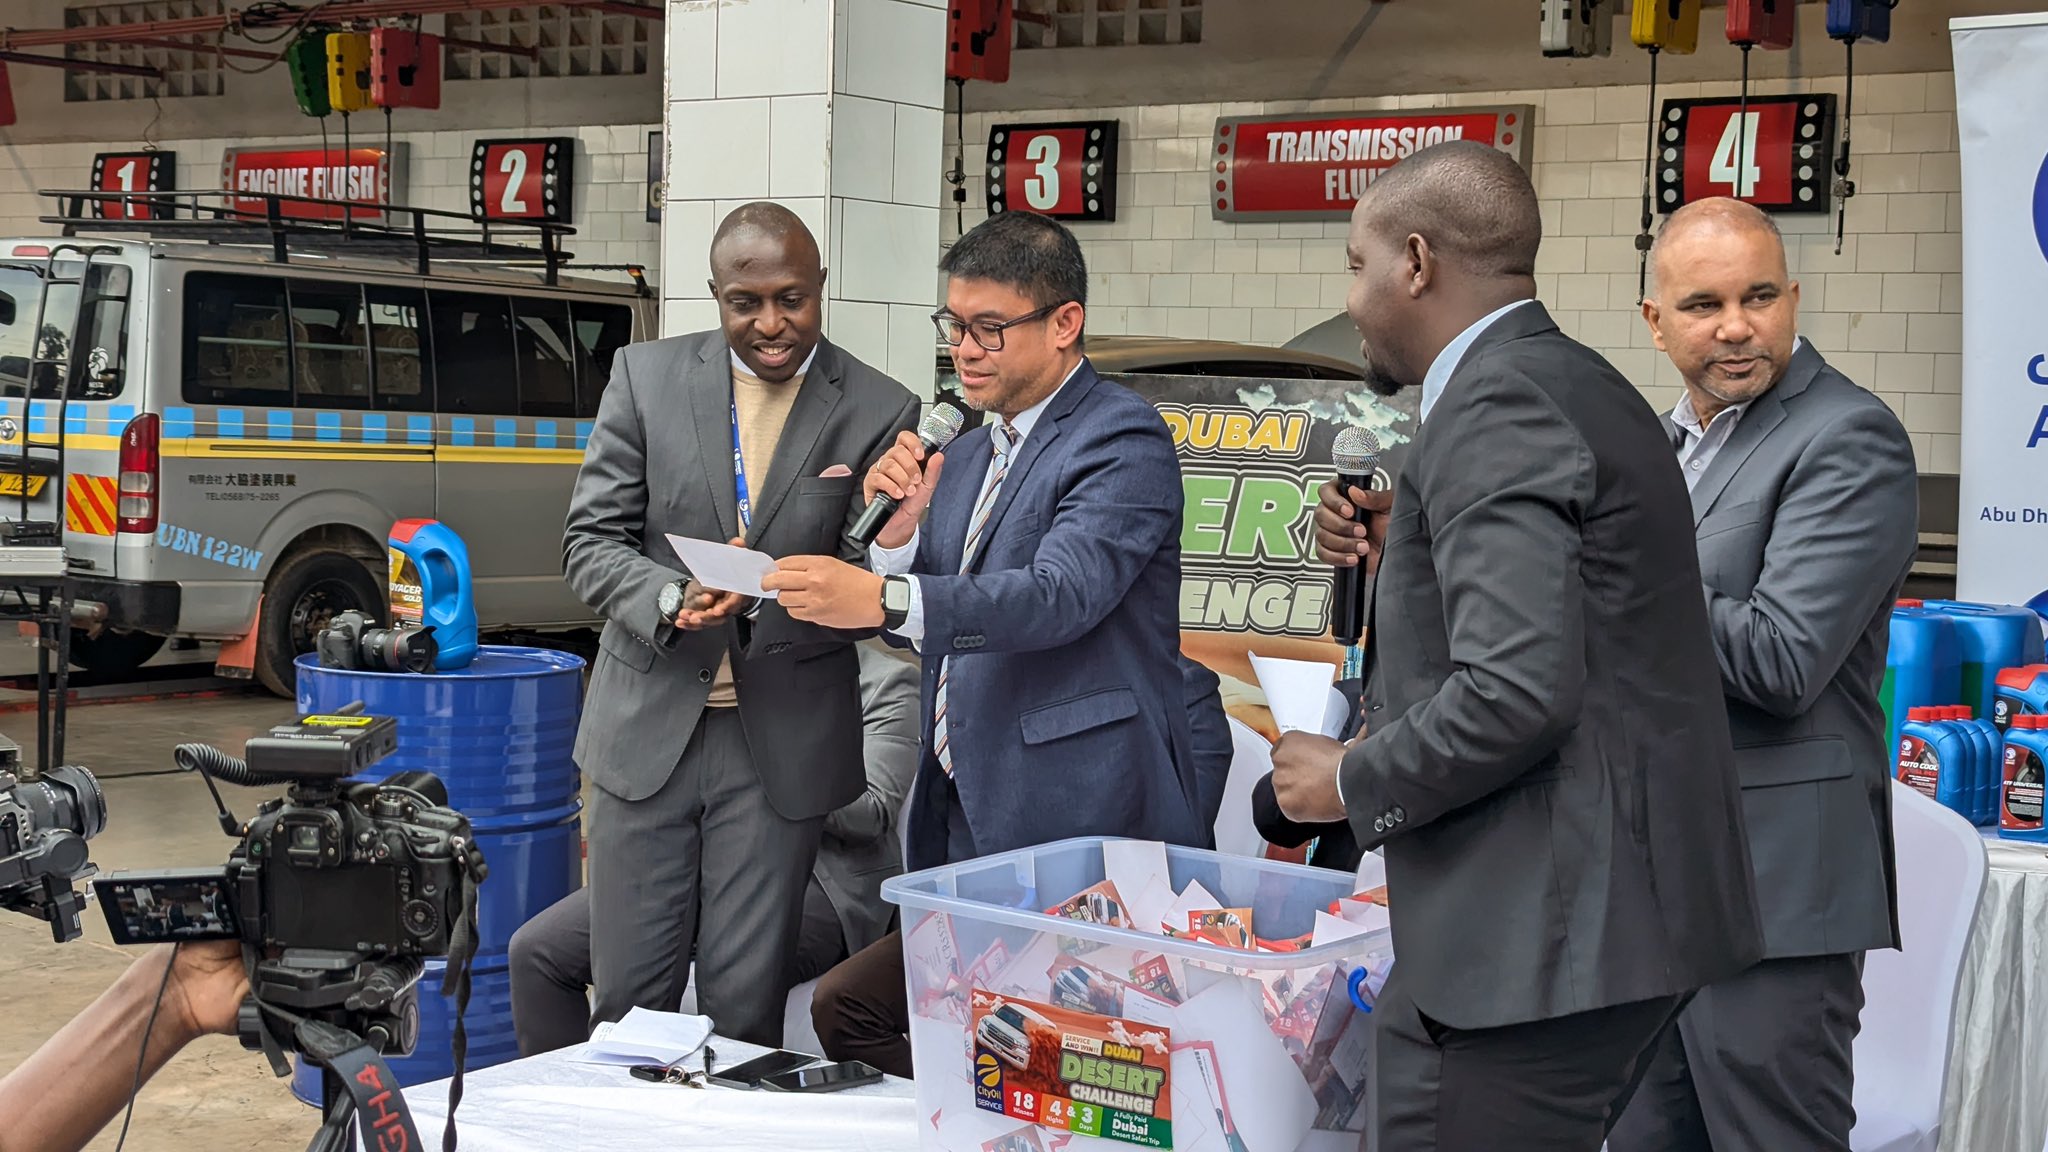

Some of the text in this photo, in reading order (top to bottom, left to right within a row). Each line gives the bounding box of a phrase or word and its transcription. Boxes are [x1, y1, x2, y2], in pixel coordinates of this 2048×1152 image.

[1709, 111, 1760, 197] 4
[500, 149, 527, 213] 2
[1025, 134, 1060, 210] 3
[117, 161, 136, 217] 1
[238, 165, 376, 202] ENGINE FLUSH
[1980, 506, 2016, 522] Abu
[156, 522, 264, 571] UBN 122W
[402, 594, 423, 603] GOLD
[1900, 760, 1938, 771] AUTO COOL
[1065, 1035, 1090, 1045] SERVICE
[1103, 1043, 1142, 1061] DUBAI
[1061, 1054, 1163, 1097] DESERT
[977, 1086, 1002, 1100] CityOil
[1013, 1091, 1034, 1110] 18
[1069, 1083, 1155, 1115] CHALLENGE
[356, 1063, 408, 1152] GH4
[977, 1098, 1003, 1111] SERVICE
[1050, 1100, 1061, 1116] 4
[1081, 1107, 1093, 1124] 3
[1046, 1115, 1064, 1125] Nights
[1079, 1123, 1093, 1131] Days
[1112, 1118, 1149, 1136] Dubai
[1119, 1113, 1134, 1122] Fully
[1134, 1115, 1147, 1123] Paid
[1111, 1130, 1160, 1146] Desert Safari Trip
